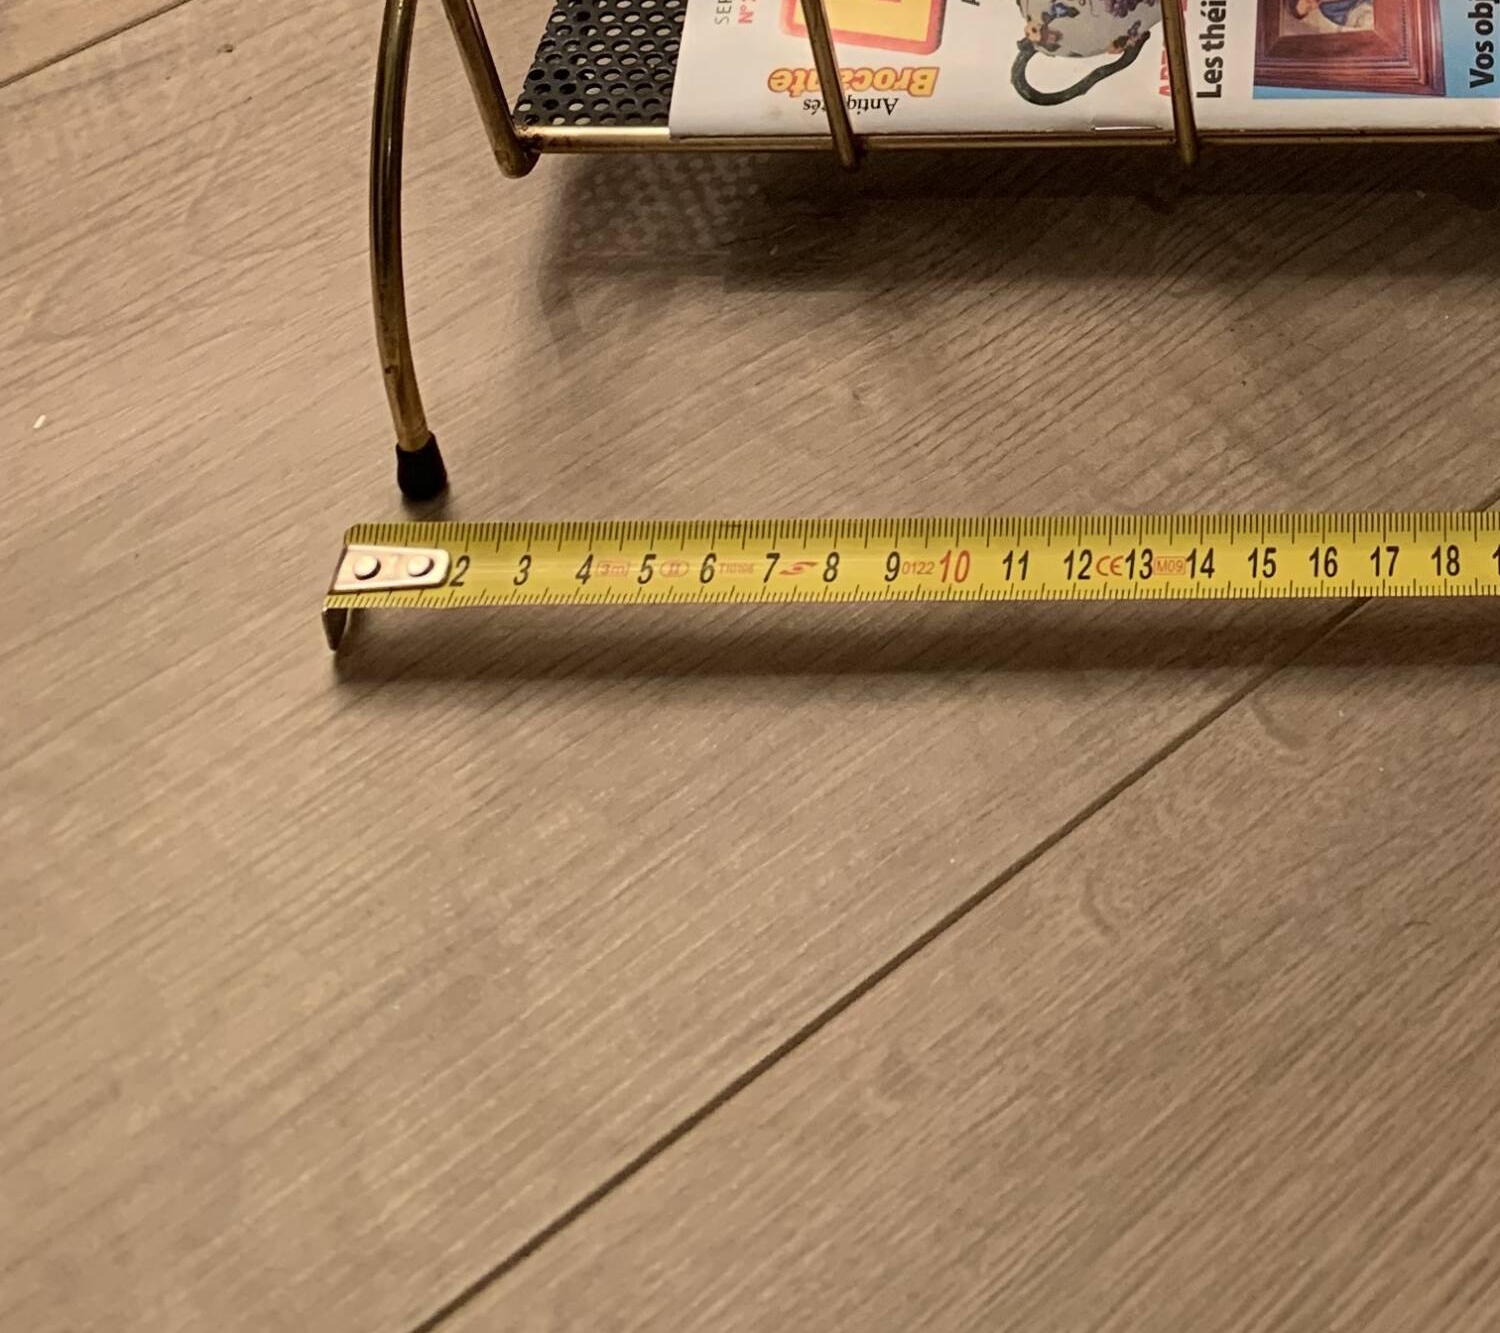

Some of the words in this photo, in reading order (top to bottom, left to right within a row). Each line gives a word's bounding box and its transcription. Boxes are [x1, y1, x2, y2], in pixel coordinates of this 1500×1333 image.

[1196, 57, 1223, 98] Les
[1469, 41, 1494, 88] Vos
[449, 555, 471, 586] 2
[513, 554, 532, 585] 3
[575, 553, 594, 585] 4
[637, 553, 657, 584] 5
[700, 552, 717, 584] 6
[762, 552, 780, 583] 7
[822, 551, 840, 582] 8
[884, 551, 900, 582] 9
[938, 550, 971, 583] 10
[1002, 550, 1029, 580] 11
[1064, 549, 1092, 580] 12
[1125, 548, 1153, 580] 13
[1185, 547, 1215, 579] 14
[1248, 547, 1277, 579] 15
[1309, 546, 1338, 578] 16
[1370, 546, 1399, 577] 17
[1431, 545, 1460, 576] 18
[902, 561, 935, 575] 0122
